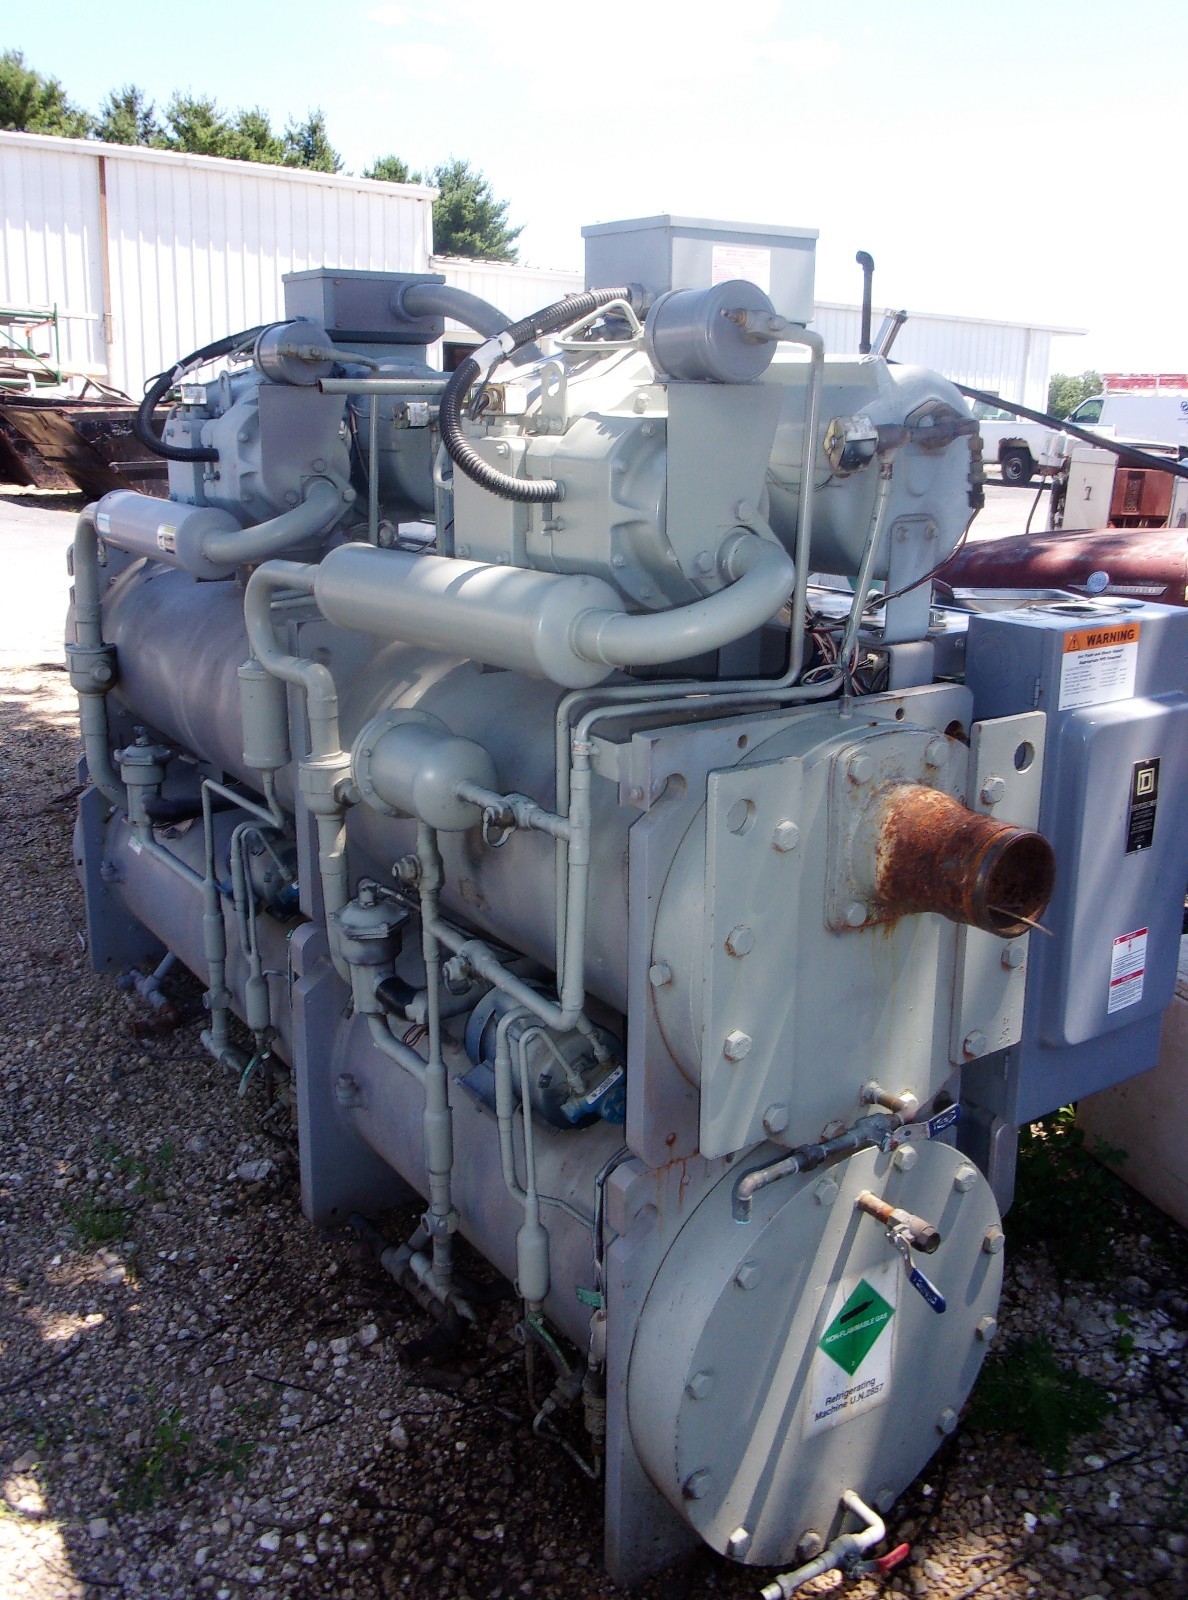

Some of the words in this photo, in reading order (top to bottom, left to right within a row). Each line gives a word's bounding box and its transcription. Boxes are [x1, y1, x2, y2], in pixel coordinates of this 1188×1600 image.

[1086, 629, 1135, 647] WARNING
[875, 1312, 888, 1323] GAS
[825, 1378, 876, 1406] Refrigerating
[814, 1401, 848, 1422] Machine
